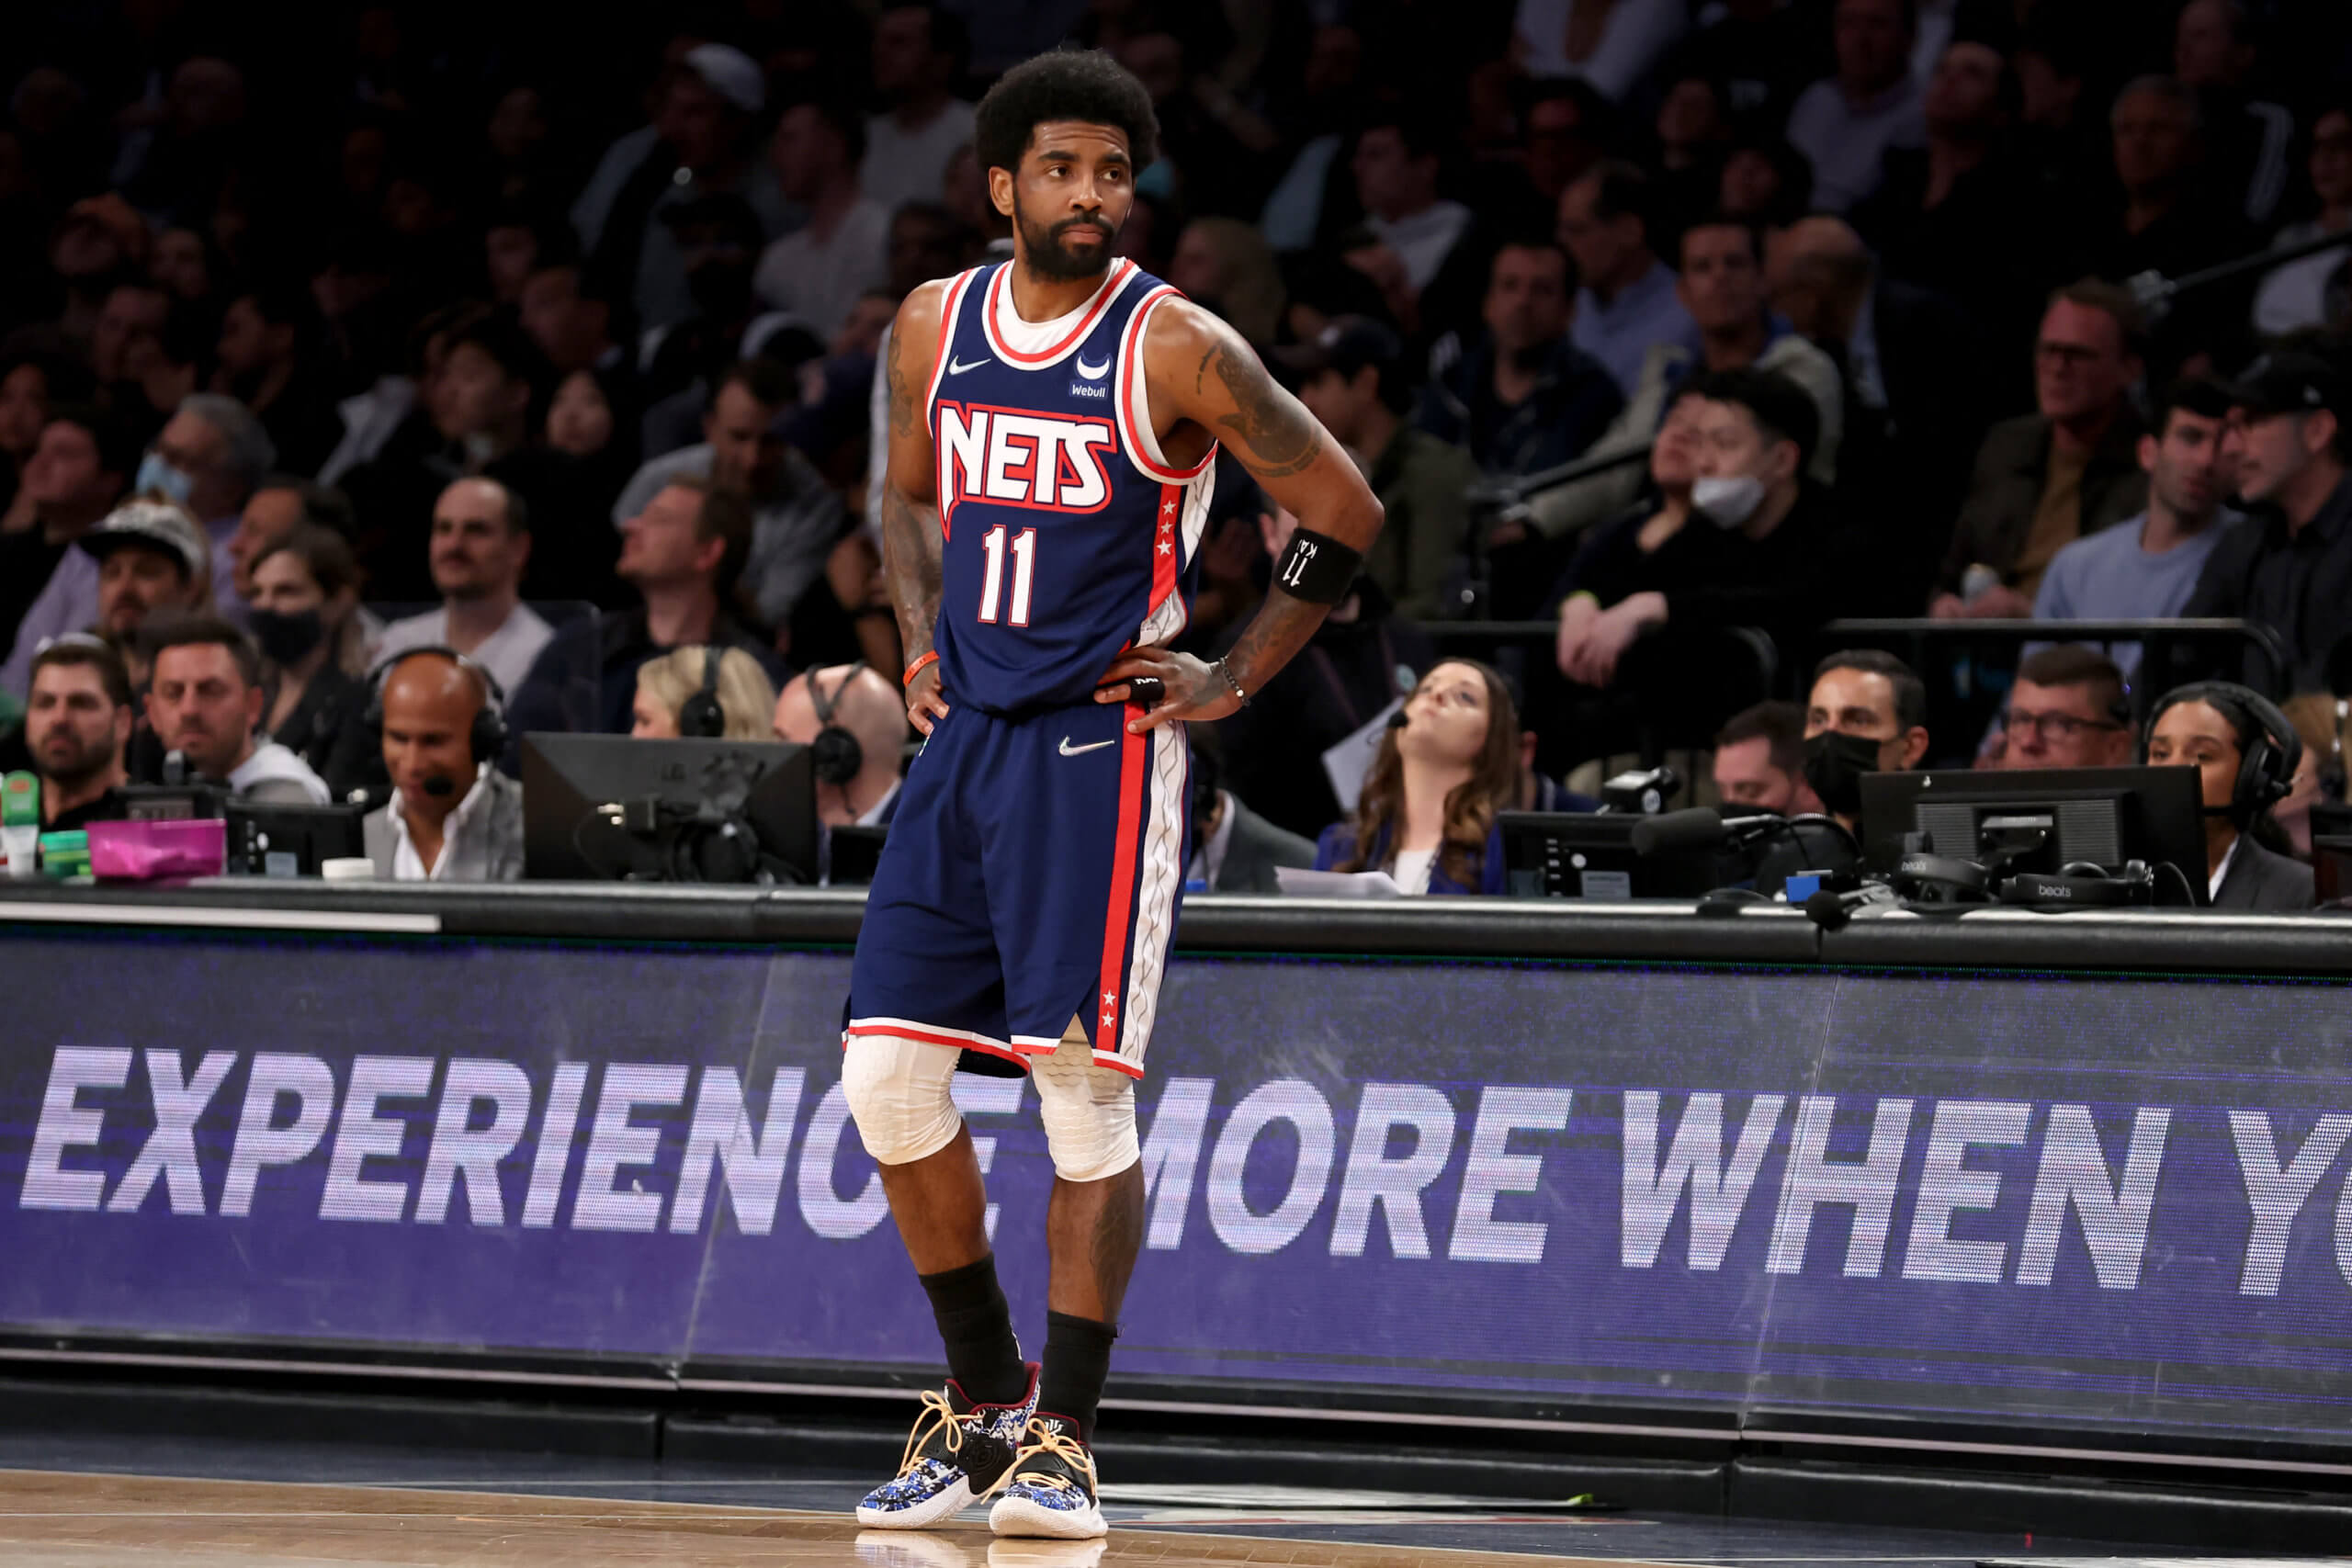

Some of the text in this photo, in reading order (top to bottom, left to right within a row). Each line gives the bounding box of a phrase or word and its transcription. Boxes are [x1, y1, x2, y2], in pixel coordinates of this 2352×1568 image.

[1072, 384, 1106, 398] Webull
[937, 400, 1117, 542] NETS
[978, 524, 1036, 627] 11
[1282, 552, 1308, 587] 11
[2039, 884, 2072, 897] beats
[1621, 1089, 2172, 1290] WHEN
[2228, 1110, 2352, 1295] Y
